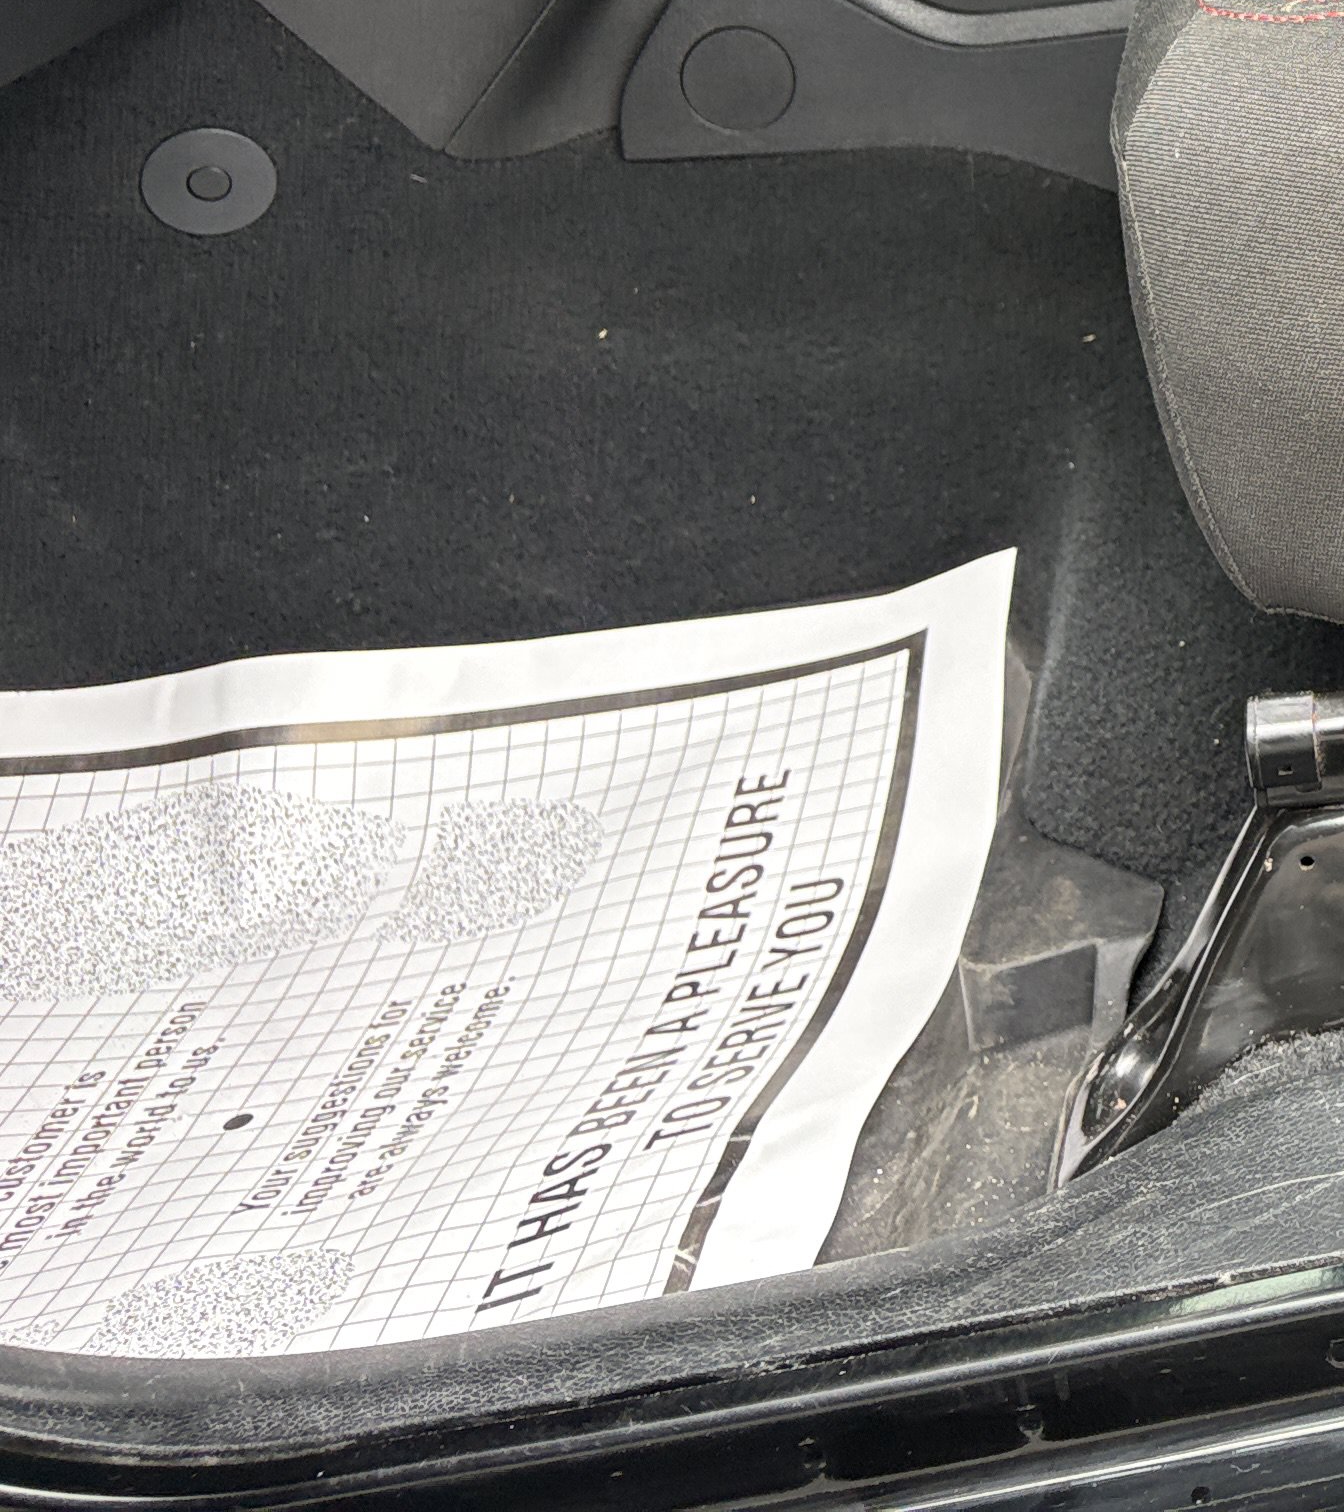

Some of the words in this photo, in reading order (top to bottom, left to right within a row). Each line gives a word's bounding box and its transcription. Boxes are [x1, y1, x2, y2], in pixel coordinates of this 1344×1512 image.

[661, 767, 793, 1007] PLEASURE
[760, 876, 846, 972] YOU
[643, 1008, 710, 1037] A
[686, 972, 811, 1091] SERVE
[0, 1192, 64, 1251] most
[38, 1075, 152, 1189] important
[135, 1001, 208, 1071] person
[64, 1070, 106, 1091] is
[229, 1168, 299, 1217] Your
[282, 1033, 392, 1163] suggestions
[368, 998, 413, 1030] for
[280, 1104, 397, 1217] improving
[373, 1065, 418, 1101] our
[399, 981, 468, 1061] service
[347, 1163, 395, 1200] are
[377, 1084, 450, 1162] always
[430, 975, 517, 1082] welcome.
[565, 1044, 689, 1139] BEEN
[642, 1094, 733, 1153] TO
[45, 1214, 95, 1240] in
[71, 1173, 127, 1211] the
[110, 1102, 179, 1169] world
[156, 1075, 198, 1100] to
[182, 1036, 228, 1070] us.
[507, 1141, 614, 1251] HAS
[474, 1261, 555, 1314] IT
